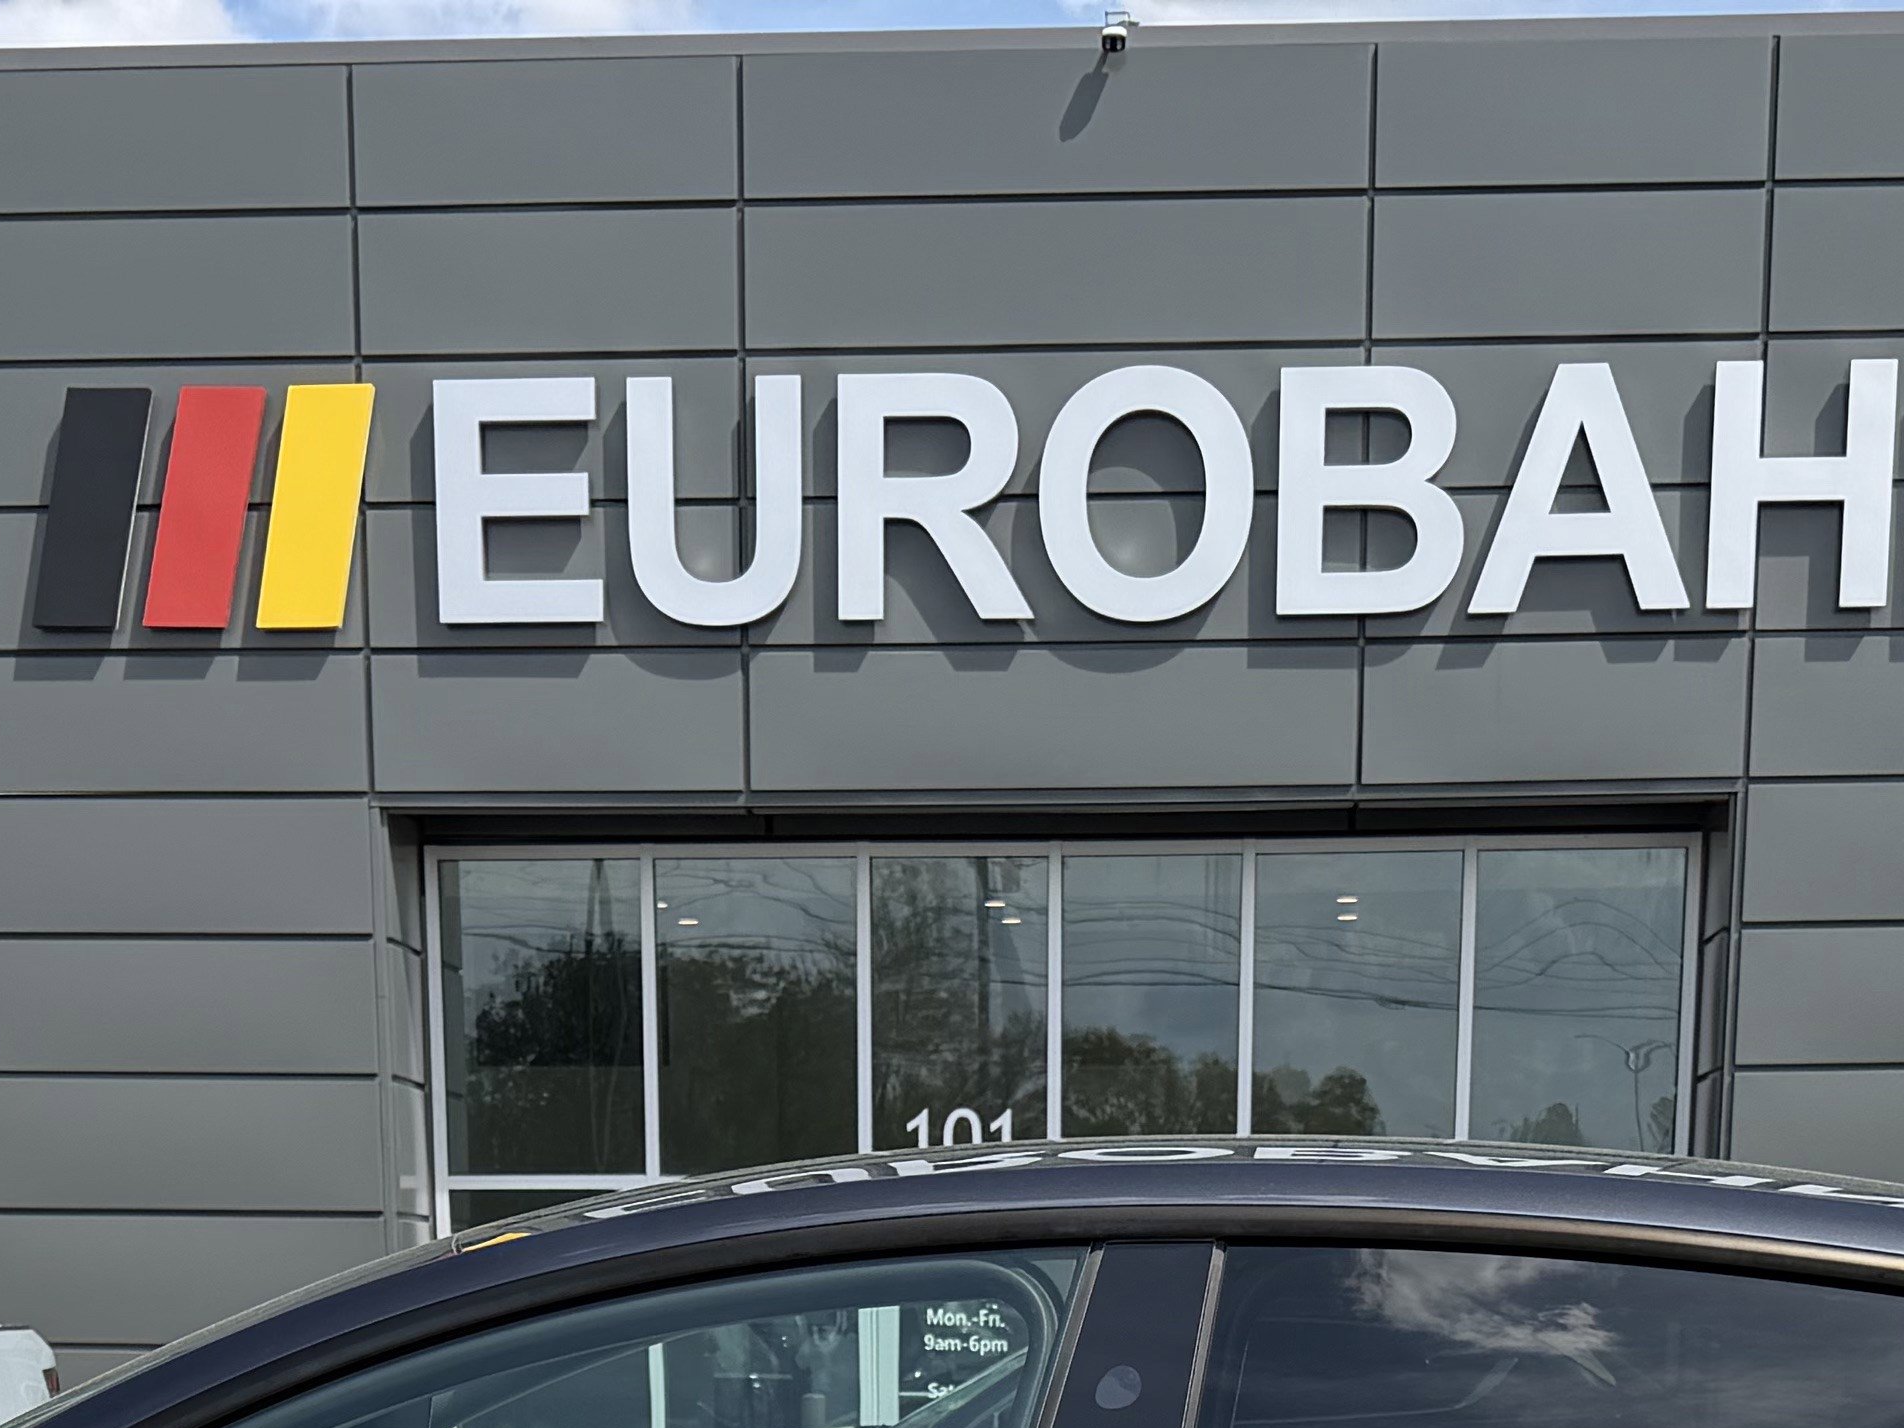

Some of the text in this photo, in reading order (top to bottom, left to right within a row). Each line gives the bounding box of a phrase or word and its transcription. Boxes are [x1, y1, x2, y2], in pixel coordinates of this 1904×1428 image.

[906, 1107, 1013, 1149] 101
[926, 1307, 1006, 1328] Mon.-Fri.
[923, 1333, 1009, 1356] 9am-6pm
